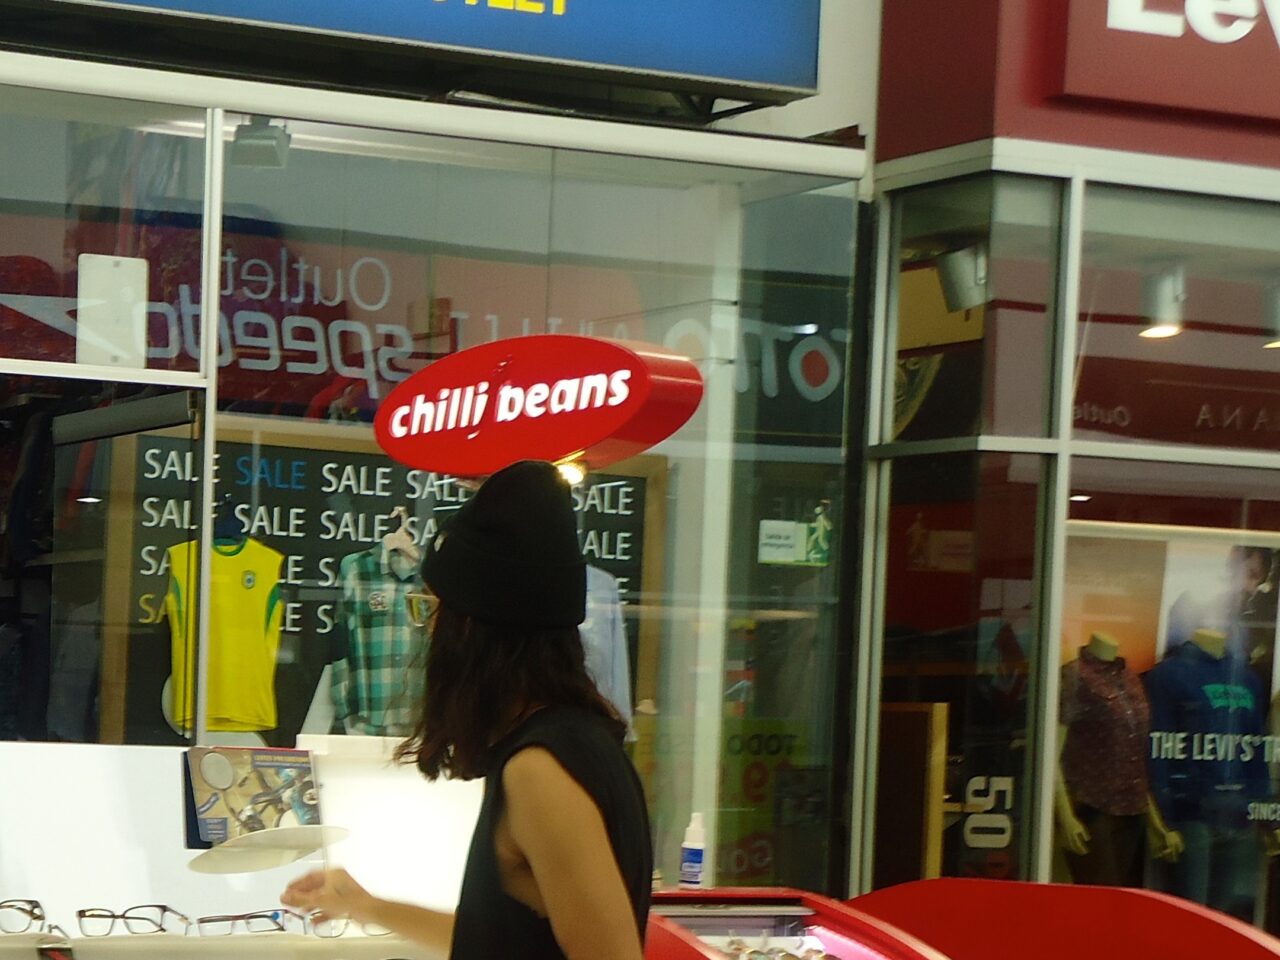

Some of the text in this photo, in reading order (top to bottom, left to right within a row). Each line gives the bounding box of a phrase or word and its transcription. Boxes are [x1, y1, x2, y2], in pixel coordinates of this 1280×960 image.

[390, 368, 632, 440] chilli beans
[236, 456, 308, 490] SALE
[321, 462, 393, 497] SALE
[235, 503, 307, 538] SALE
[320, 510, 390, 543] SALE
[577, 530, 633, 561] ALE
[1150, 731, 1188, 760] THE
[963, 775, 1015, 849] 50
